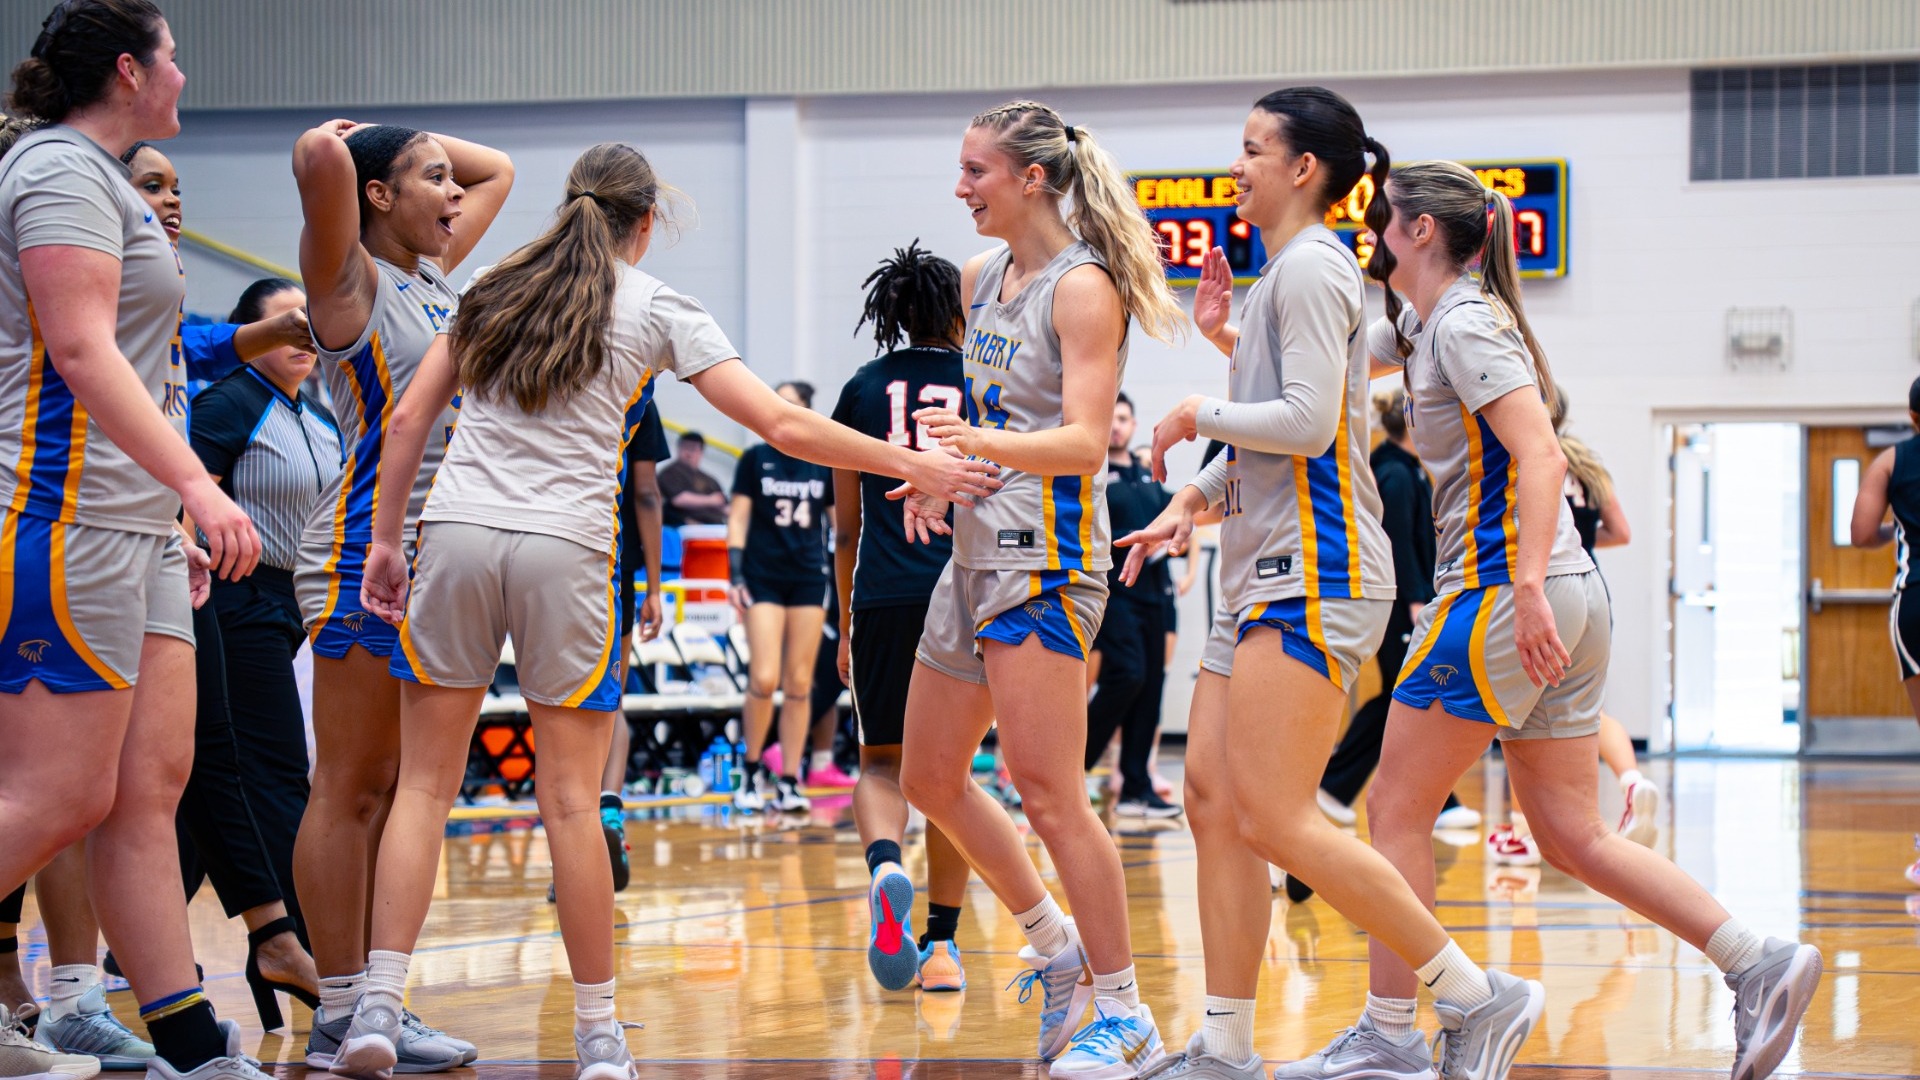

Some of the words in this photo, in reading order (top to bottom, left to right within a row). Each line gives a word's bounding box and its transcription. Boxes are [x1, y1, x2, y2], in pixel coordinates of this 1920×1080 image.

[1157, 220, 1214, 267] 73
[964, 327, 1023, 372] EMBRY
[886, 379, 963, 450] 12
[774, 499, 811, 528] 34
[1023, 534, 1029, 543] L
[1281, 561, 1288, 570] L
